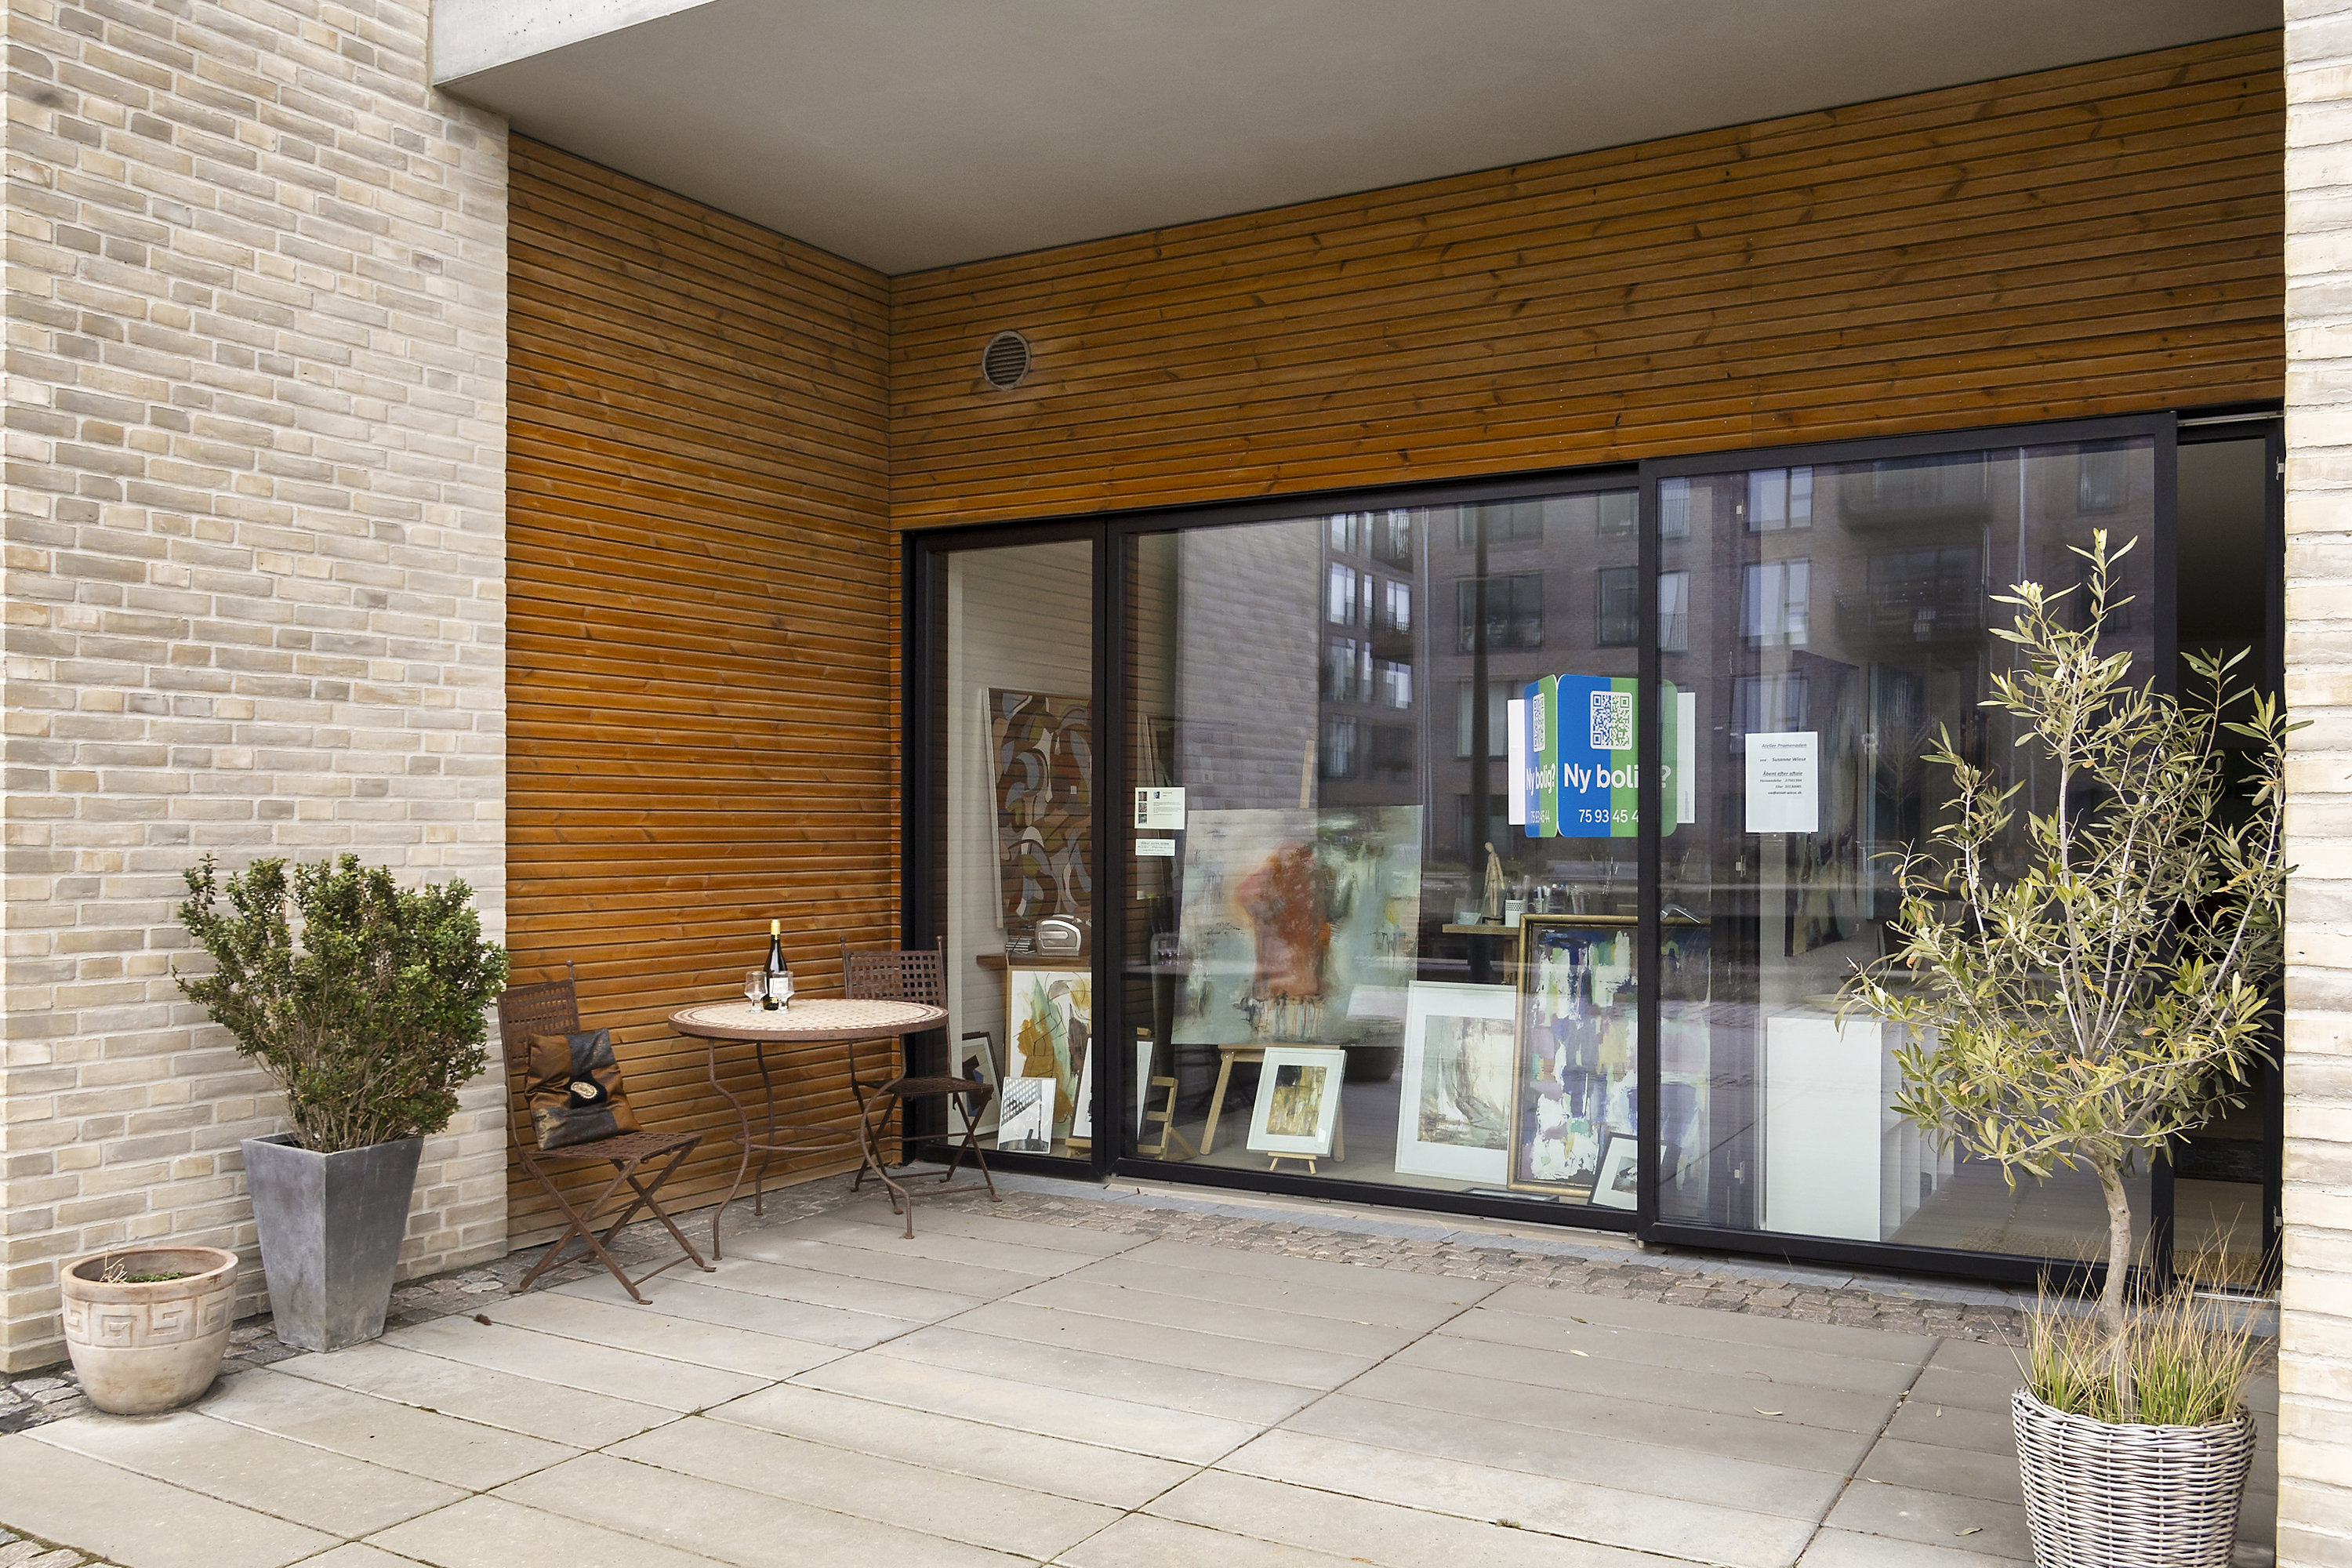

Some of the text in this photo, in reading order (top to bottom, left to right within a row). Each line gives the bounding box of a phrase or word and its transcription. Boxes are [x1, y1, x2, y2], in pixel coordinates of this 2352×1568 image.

[1526, 763, 1555, 796] Ny bolig?
[1564, 763, 1671, 793] Ny boli?
[1578, 809, 1639, 823] 75 93 45 4
